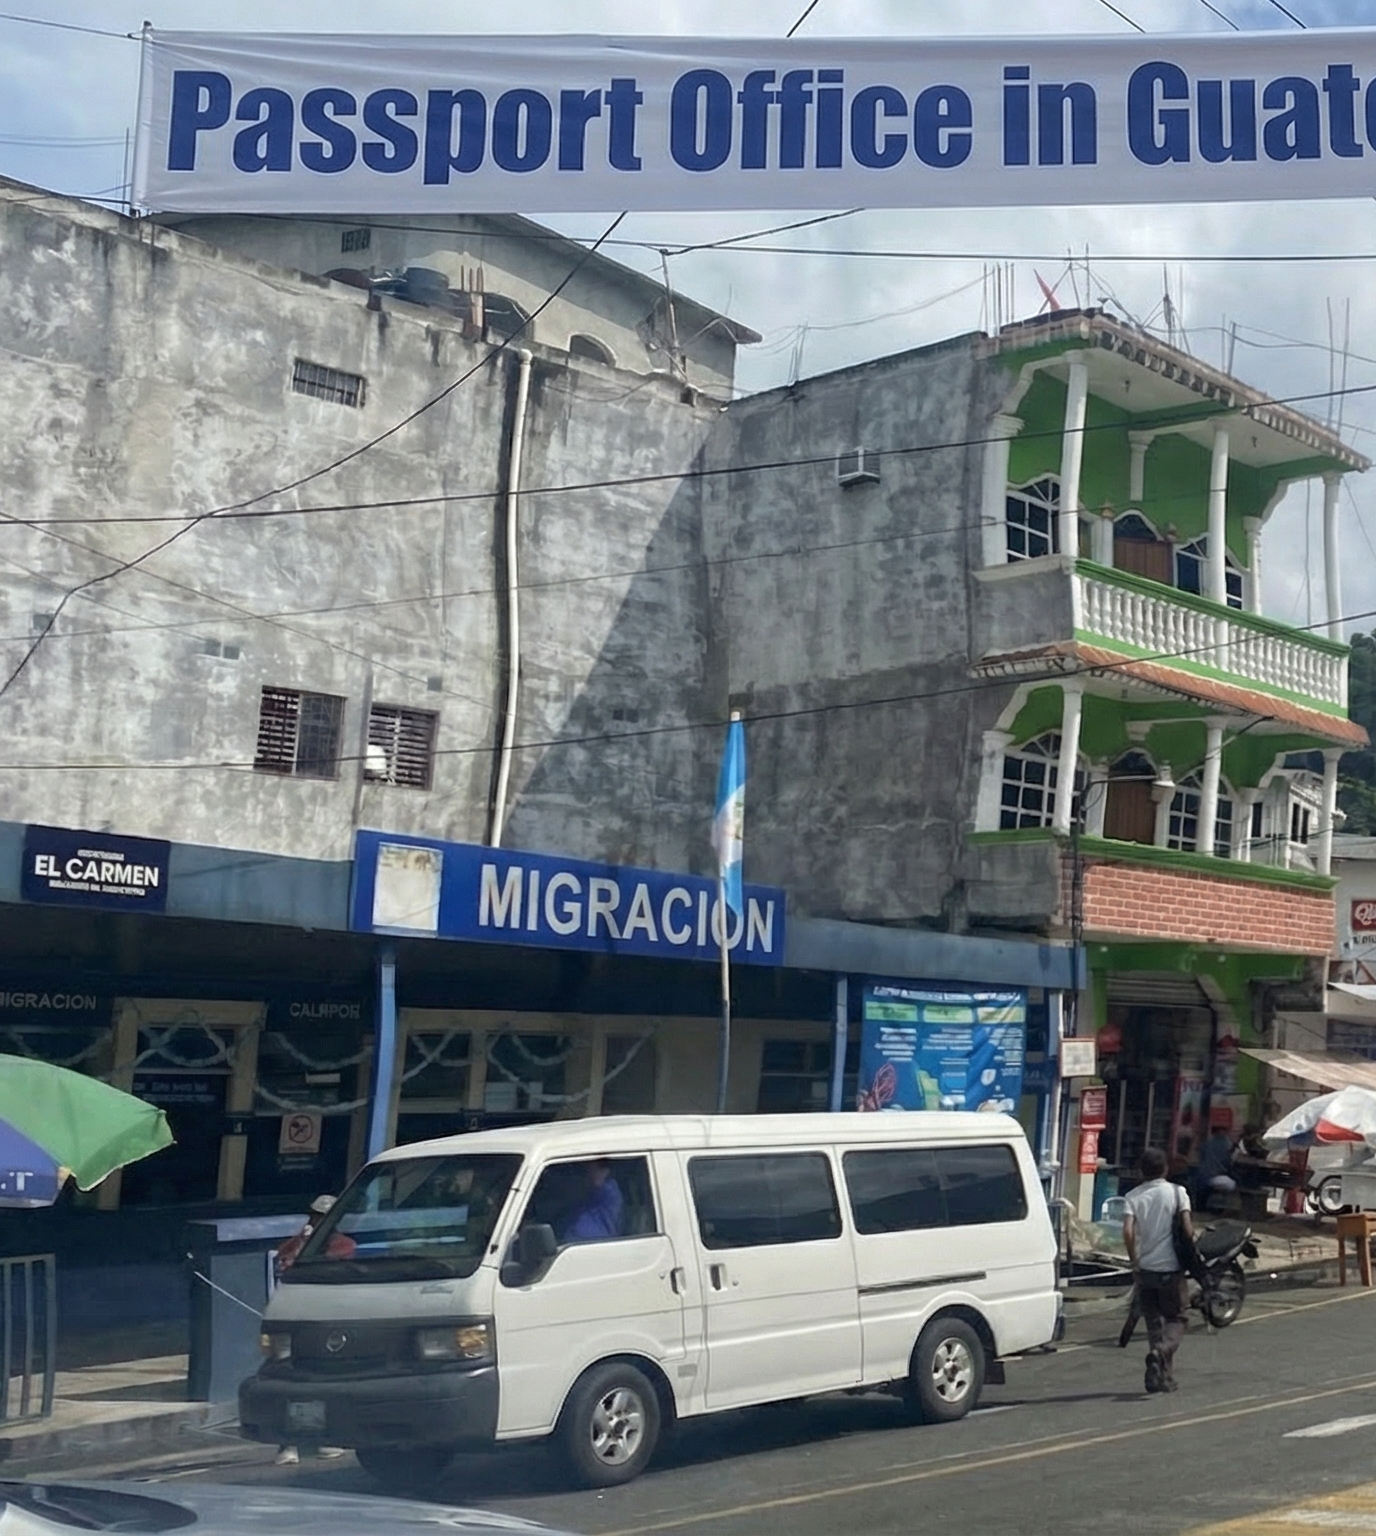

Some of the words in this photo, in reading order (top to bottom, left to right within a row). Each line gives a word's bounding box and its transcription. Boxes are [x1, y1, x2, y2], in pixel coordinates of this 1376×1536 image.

[167, 69, 645, 186] Passport
[669, 68, 974, 173] Office
[1003, 65, 1099, 168] in
[35, 854, 61, 877] EL
[65, 858, 159, 888] CARMEN
[478, 863, 775, 953] MIGRACION
